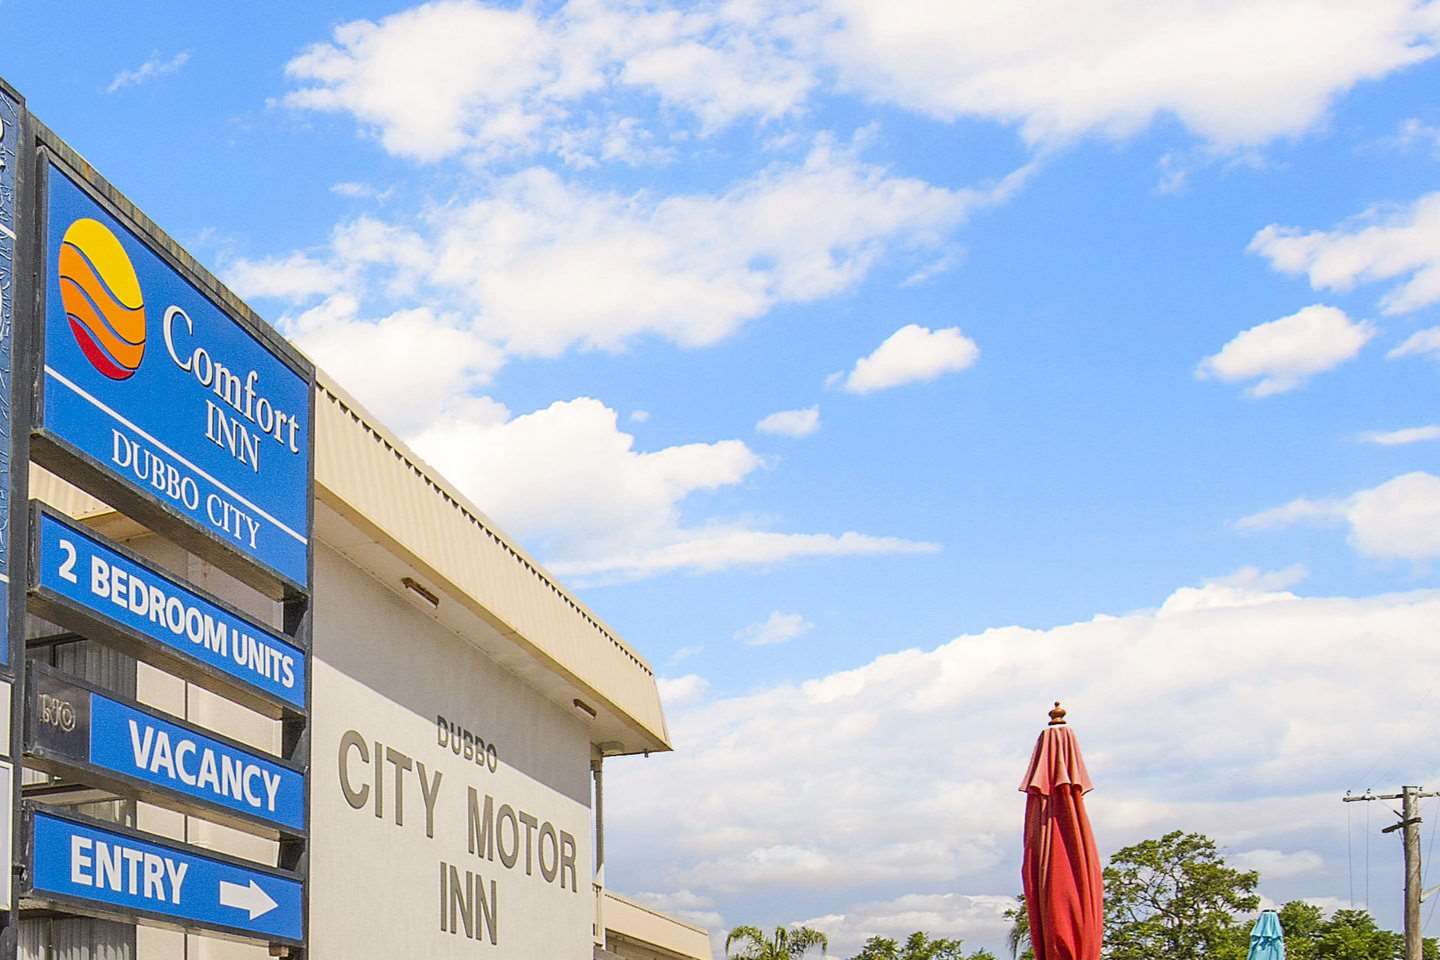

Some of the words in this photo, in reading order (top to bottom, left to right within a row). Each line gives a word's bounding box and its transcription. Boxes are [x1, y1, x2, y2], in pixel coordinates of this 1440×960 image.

[163, 304, 300, 454] Comfort
[205, 400, 261, 473] INN
[111, 428, 199, 510] DUBBO
[207, 493, 260, 549] CITY
[58, 539, 77, 584] 2
[91, 555, 227, 657] BEDROOM
[232, 630, 294, 688] UNITS
[129, 719, 281, 812] VACANCY
[437, 715, 498, 774] DUBBO
[338, 730, 443, 839] CITY
[468, 785, 577, 893] MOTOR
[71, 835, 188, 904] ENTRY
[440, 861, 498, 945] INN
